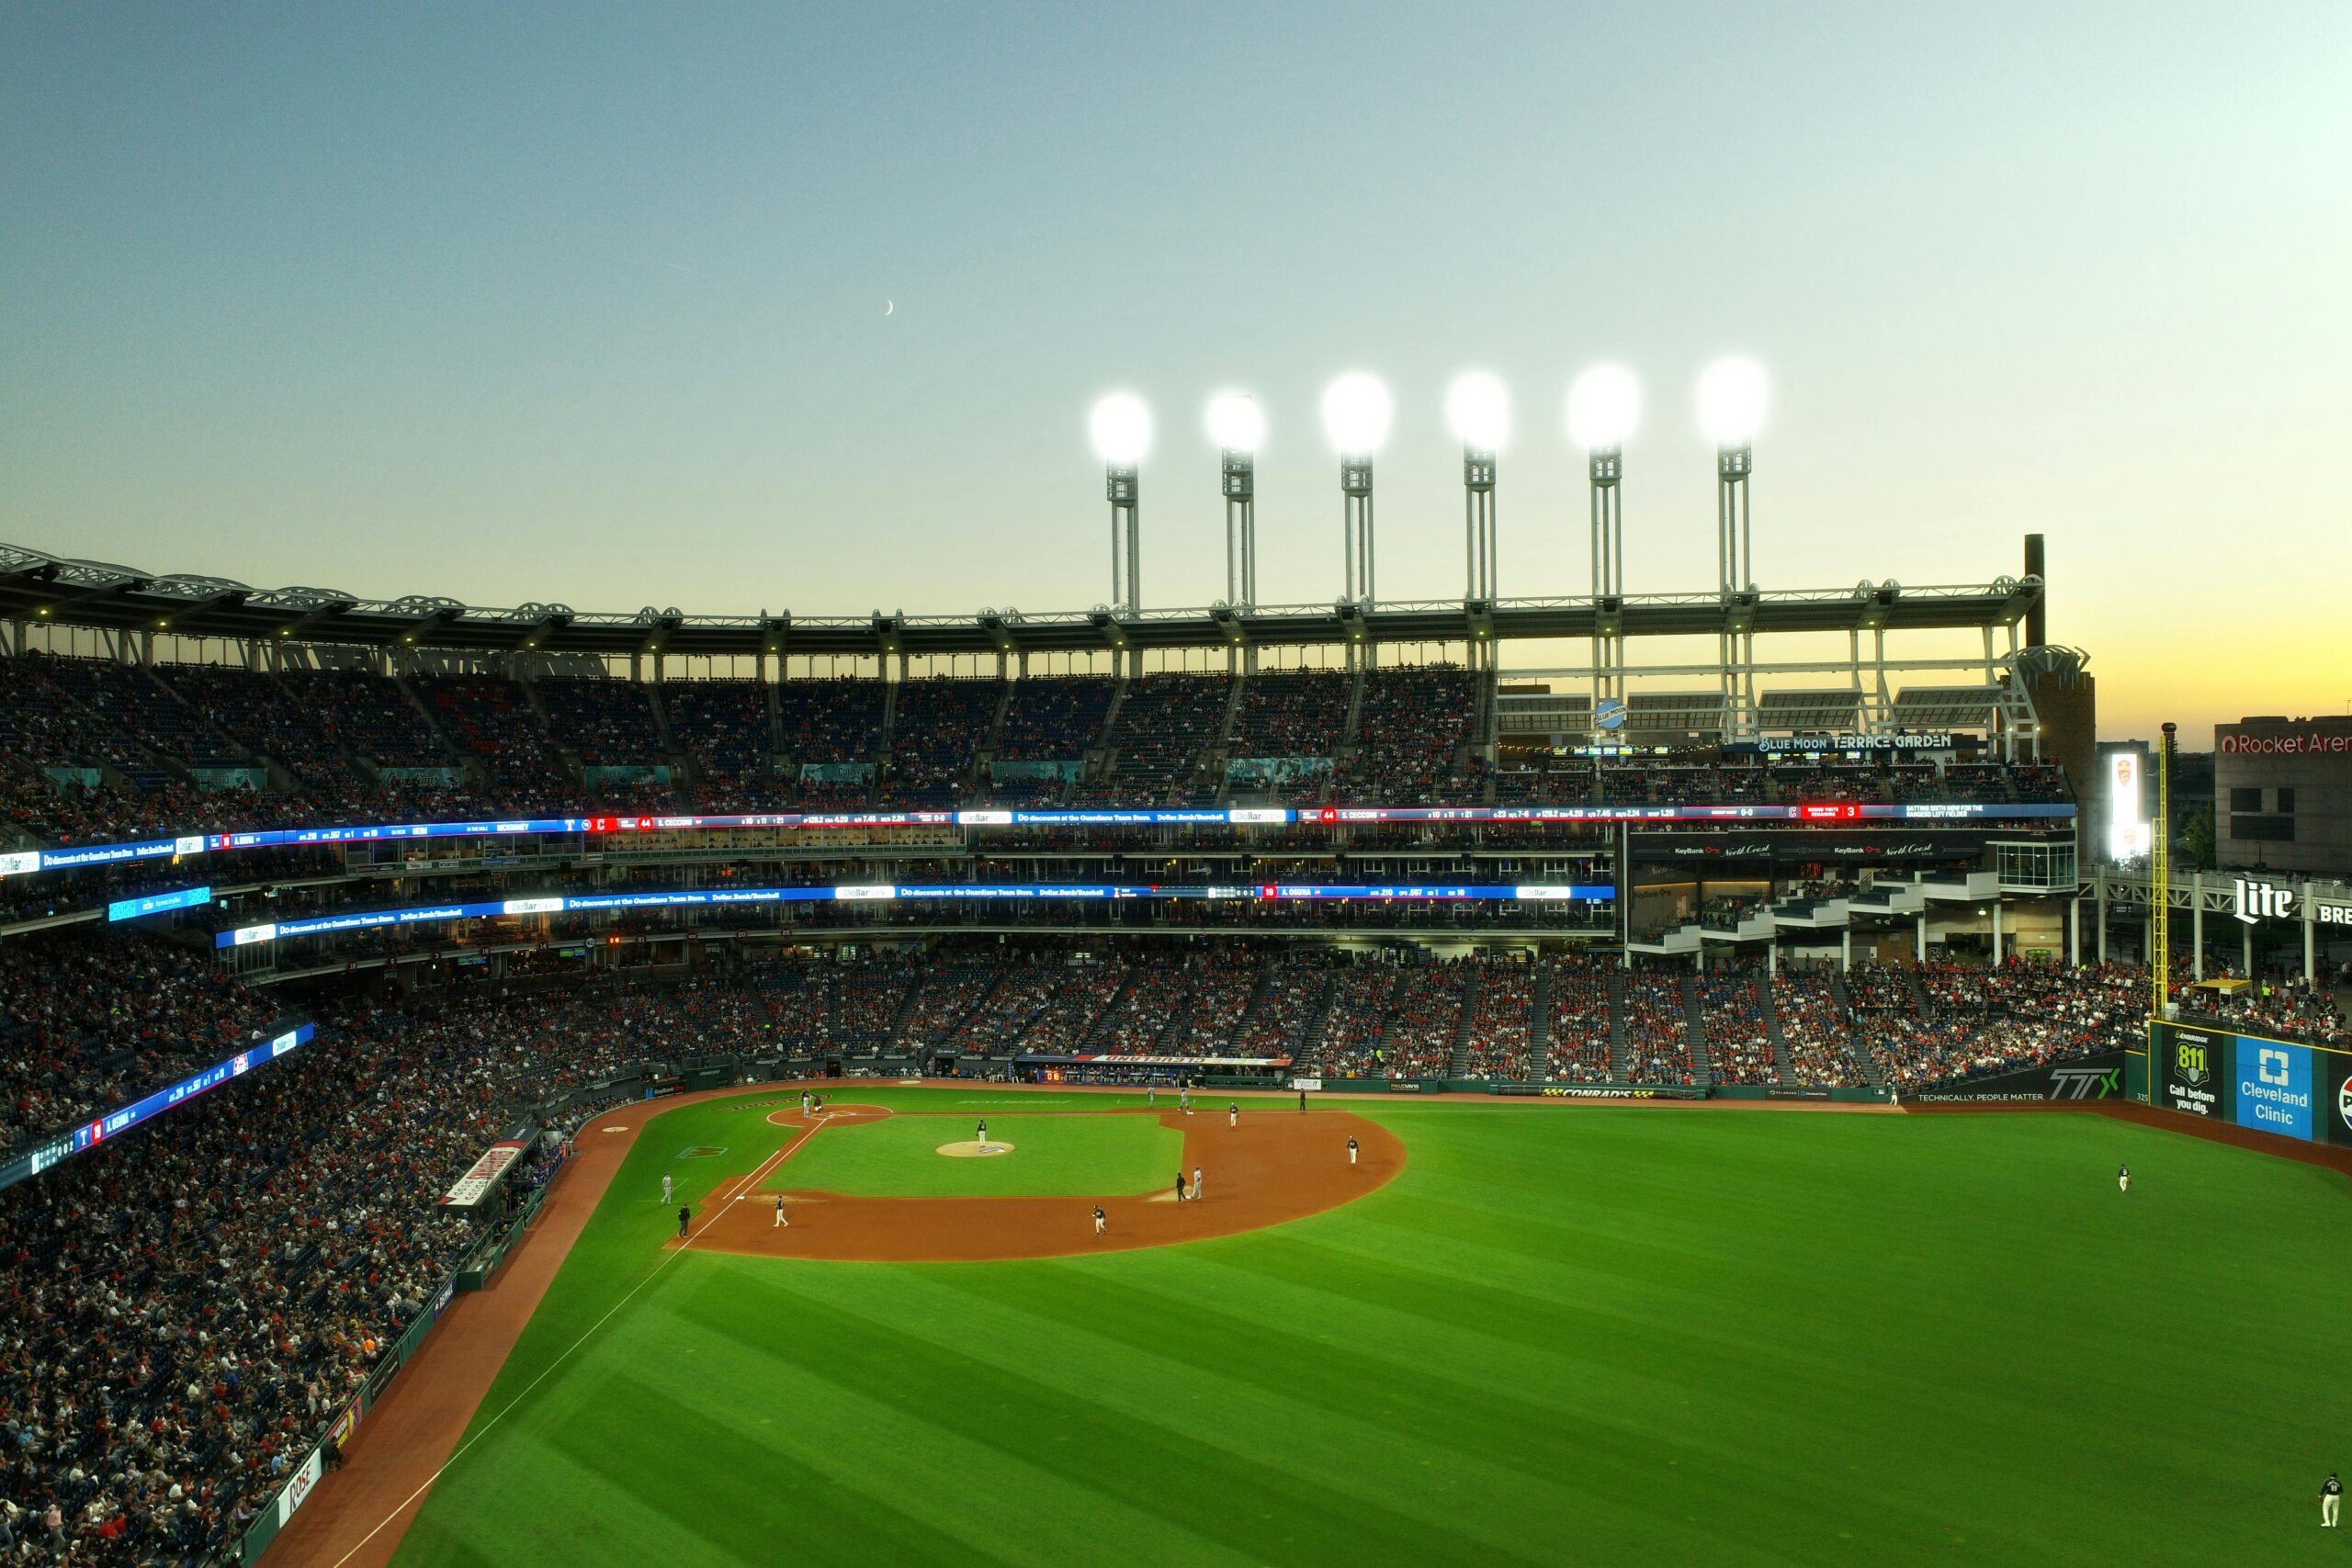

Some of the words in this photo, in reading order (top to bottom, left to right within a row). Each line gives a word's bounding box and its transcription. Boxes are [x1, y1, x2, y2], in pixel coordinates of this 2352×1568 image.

[1594, 713, 1609, 724] BLUE
[1611, 707, 1626, 716] MOON
[1759, 738, 1790, 751] BLUE
[1794, 739, 1826, 749] MOON
[1832, 736, 1890, 749] TERRACE
[1895, 735, 1951, 748] GARDEN
[2239, 735, 2304, 753] Rocket
[1848, 807, 1854, 816] 3
[565, 820, 575, 831] T
[597, 819, 605, 830] C
[1721, 846, 1745, 857] North
[1747, 844, 1770, 853] Coast
[1882, 846, 1907, 857] North
[1908, 844, 1932, 853] Coast
[2233, 878, 2293, 925] Lite
[2320, 905, 2352, 925] BRE
[280, 926, 289, 935] Do
[290, 924, 316, 933] discounts
[332, 919, 360, 928] Guardians
[379, 915, 396, 924] Store.
[2180, 1032, 2208, 1043] ENBRIDGE
[2178, 1045, 2205, 1071] 811
[2049, 1068, 2120, 1100] TTX
[2170, 1084, 2185, 1096] Call
[2188, 1087, 2215, 1102] before
[1562, 1089, 1631, 1098] CONRAD'S
[2137, 1093, 2148, 1101] 325
[2242, 1081, 2307, 1107] Cleveland
[2177, 1099, 2192, 1111] you
[2193, 1100, 2208, 1115] dig.
[2256, 1104, 2293, 1125] Clinic
[80, 1130, 87, 1146] T
[94, 1125, 101, 1139] 19
[289, 1464, 310, 1514] ROSE
